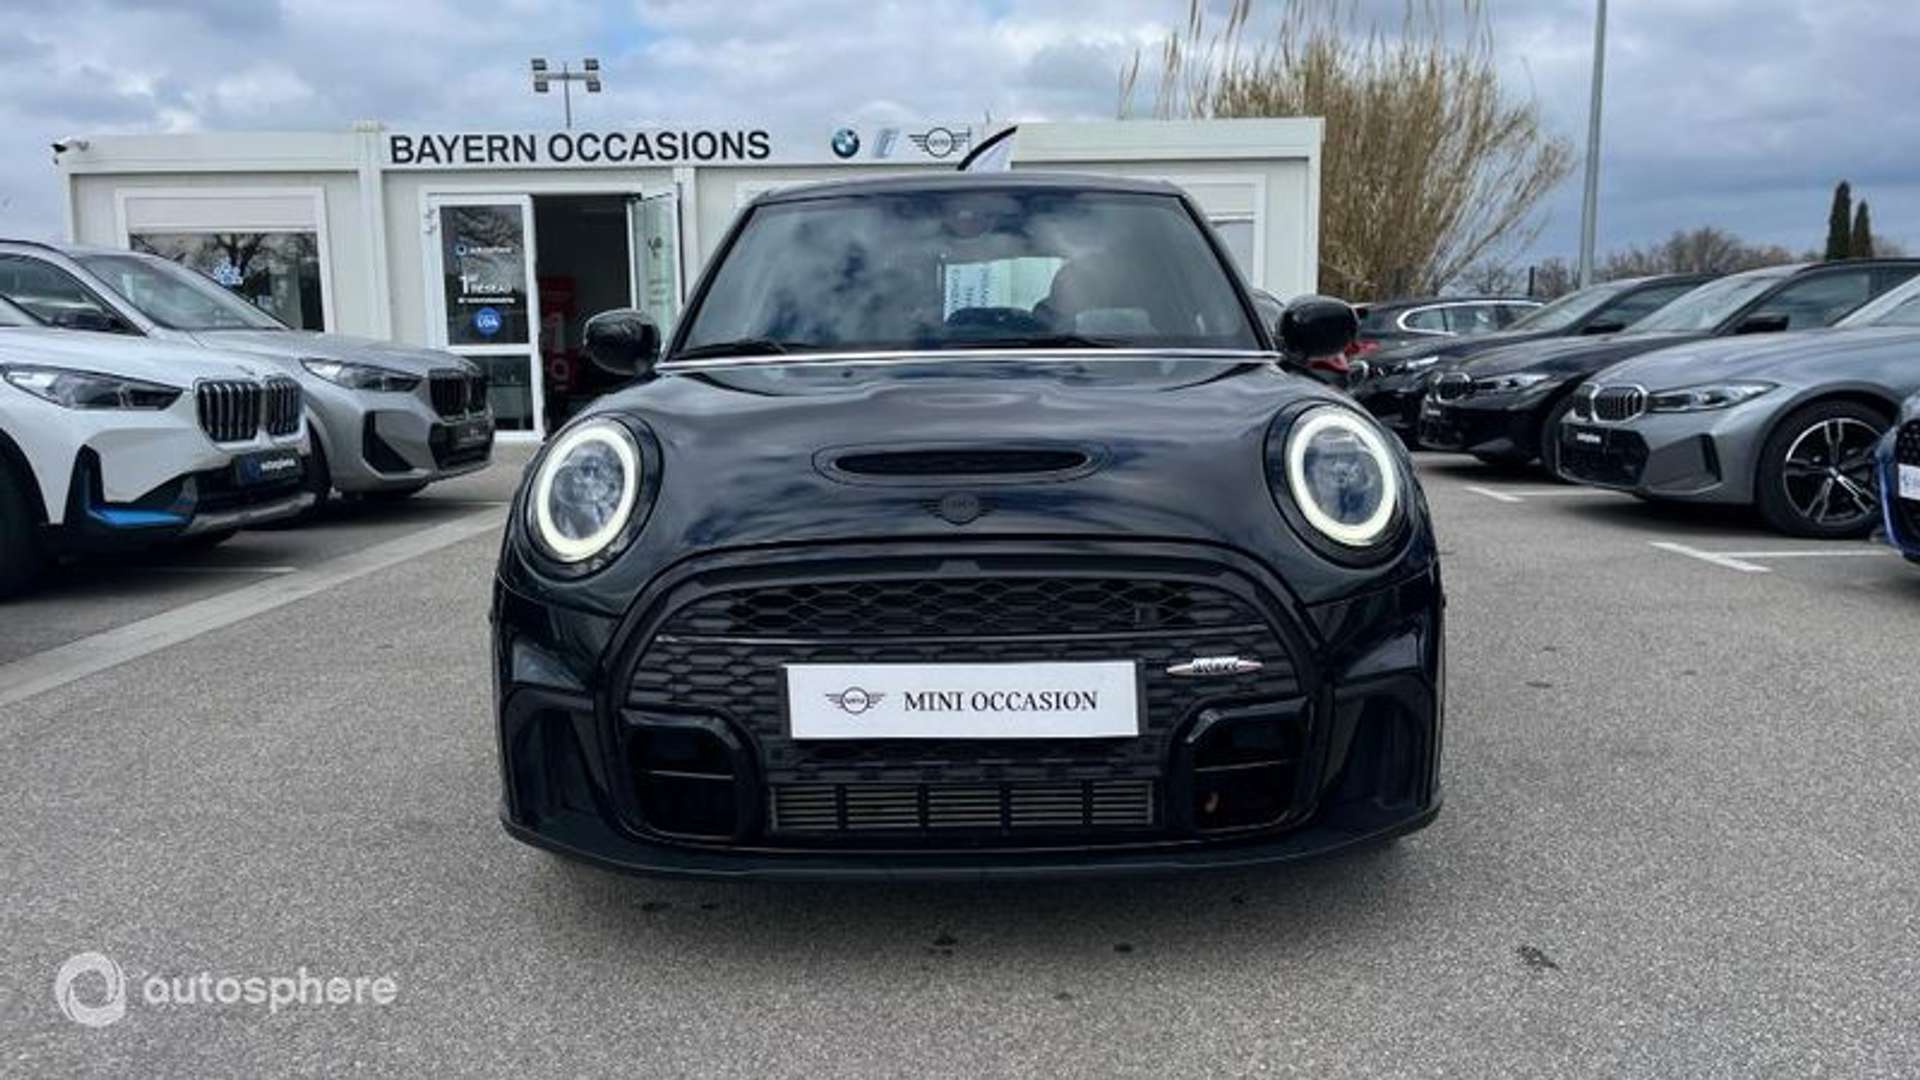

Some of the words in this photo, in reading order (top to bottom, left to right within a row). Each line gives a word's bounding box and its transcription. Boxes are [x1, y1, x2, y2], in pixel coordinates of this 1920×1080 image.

[390, 134, 537, 164] BAYERN
[549, 131, 770, 162] OCCASIONS
[904, 690, 964, 712] MINI
[971, 690, 1098, 712] OCCASION
